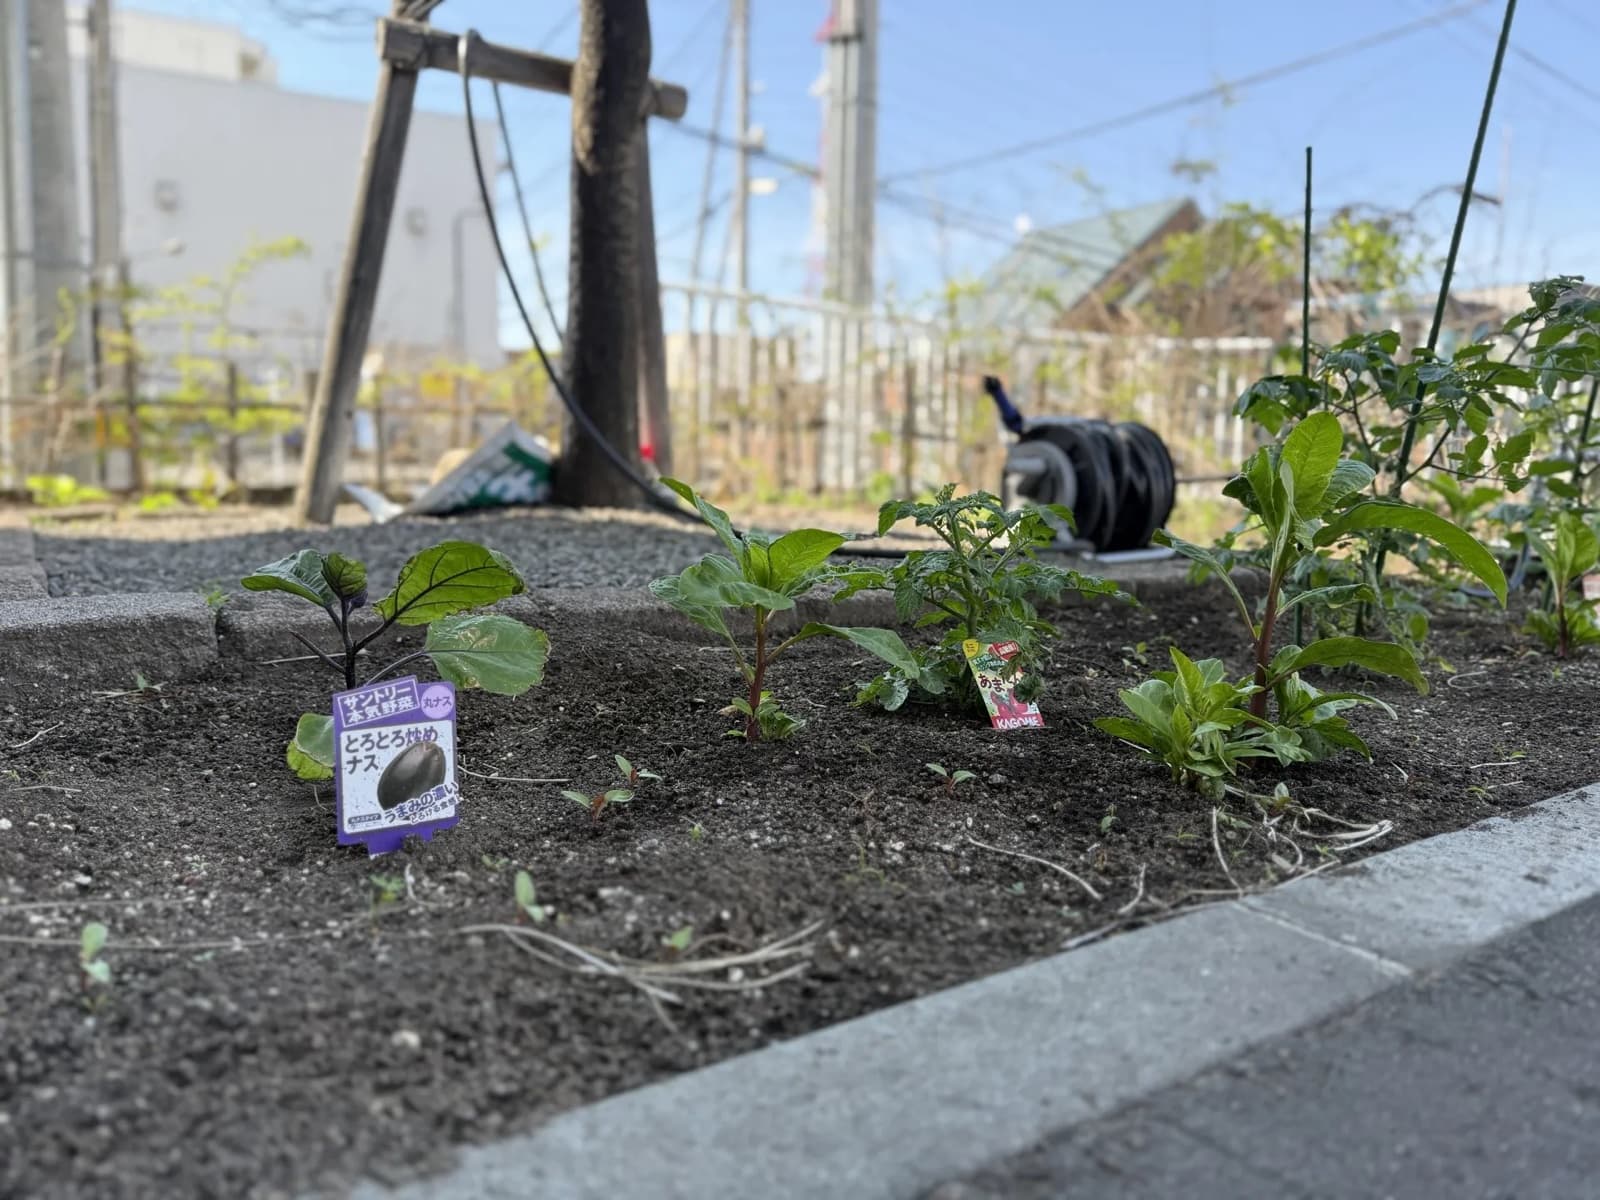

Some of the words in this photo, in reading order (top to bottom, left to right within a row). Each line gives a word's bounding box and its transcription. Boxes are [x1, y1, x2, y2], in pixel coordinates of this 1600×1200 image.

[344, 687, 411, 711] サントリー
[347, 695, 417, 724] 本気野菜
[996, 716, 1041, 729] KAGOME
[346, 753, 379, 775] ナス
